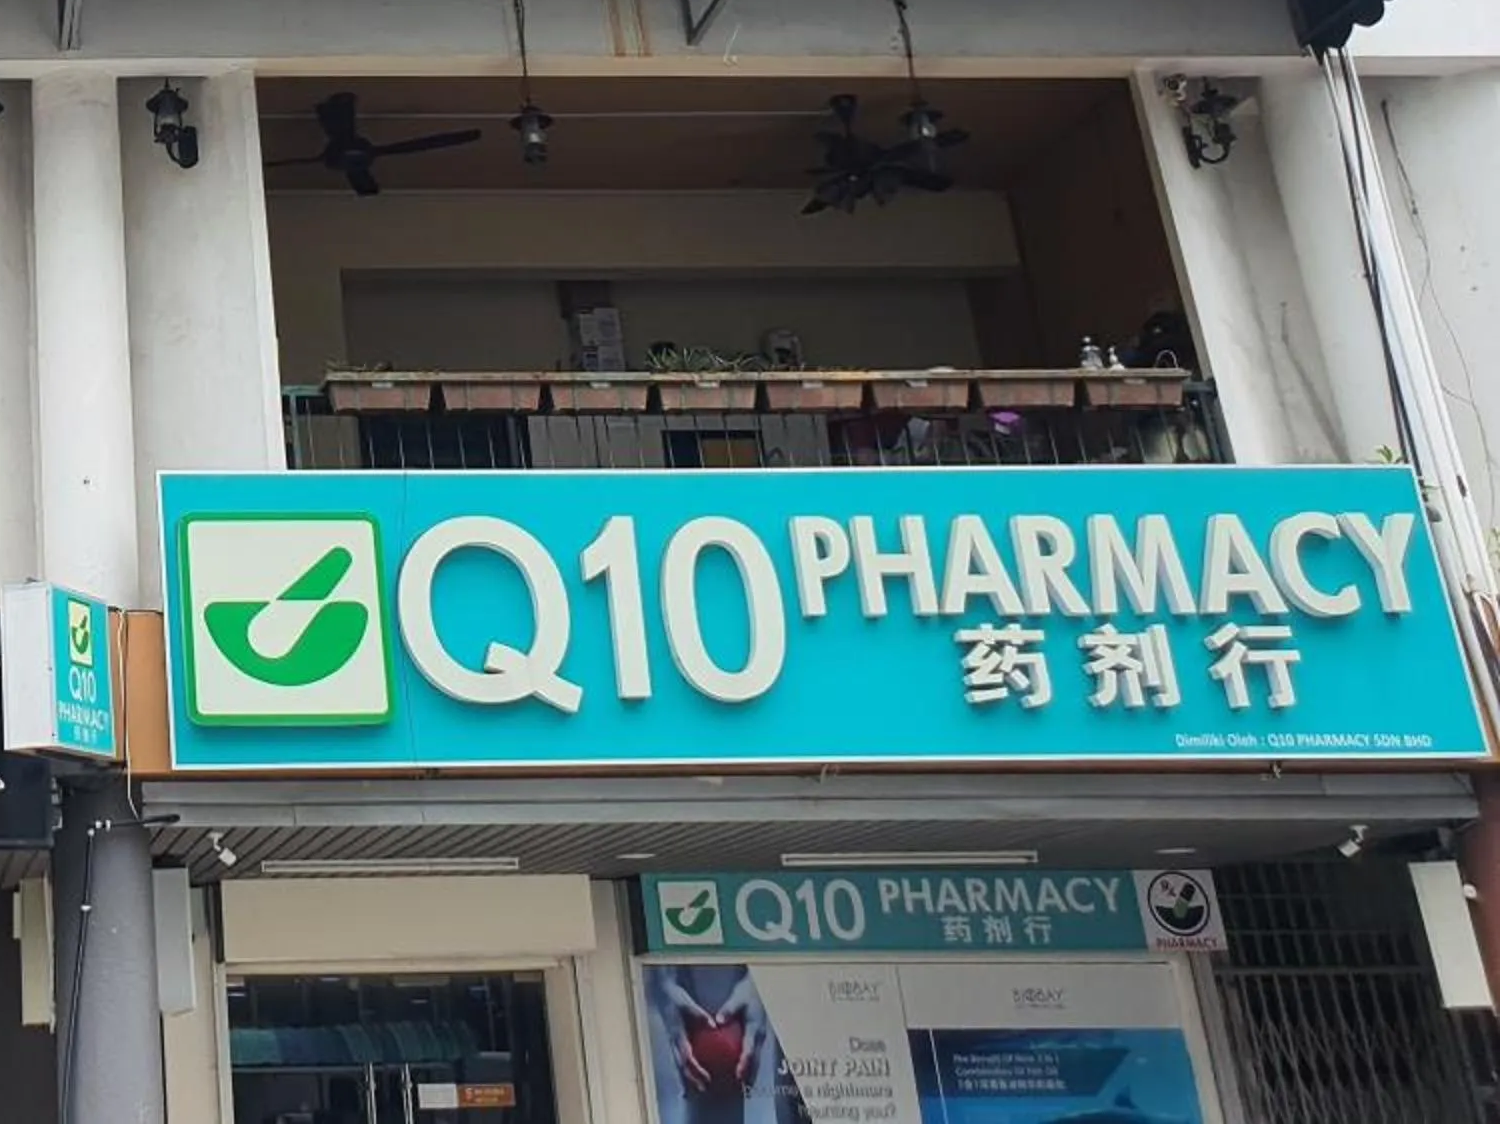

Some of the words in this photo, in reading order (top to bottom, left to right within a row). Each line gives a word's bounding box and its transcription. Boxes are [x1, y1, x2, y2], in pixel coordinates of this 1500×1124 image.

[398, 514, 787, 714] Q10
[789, 511, 1415, 618] PHARMACY
[68, 666, 97, 704] Q10
[955, 623, 1301, 710] 药剂行
[1227, 733, 1257, 748] Oleh
[1268, 733, 1294, 748] Q10
[1297, 734, 1370, 748] PHARMACY
[1404, 734, 1432, 748] BHD
[734, 875, 865, 945] Q10
[878, 878, 1122, 914] PHARMACY
[943, 915, 1052, 945] 药剂行
[844, 1058, 891, 1077] PAIN
